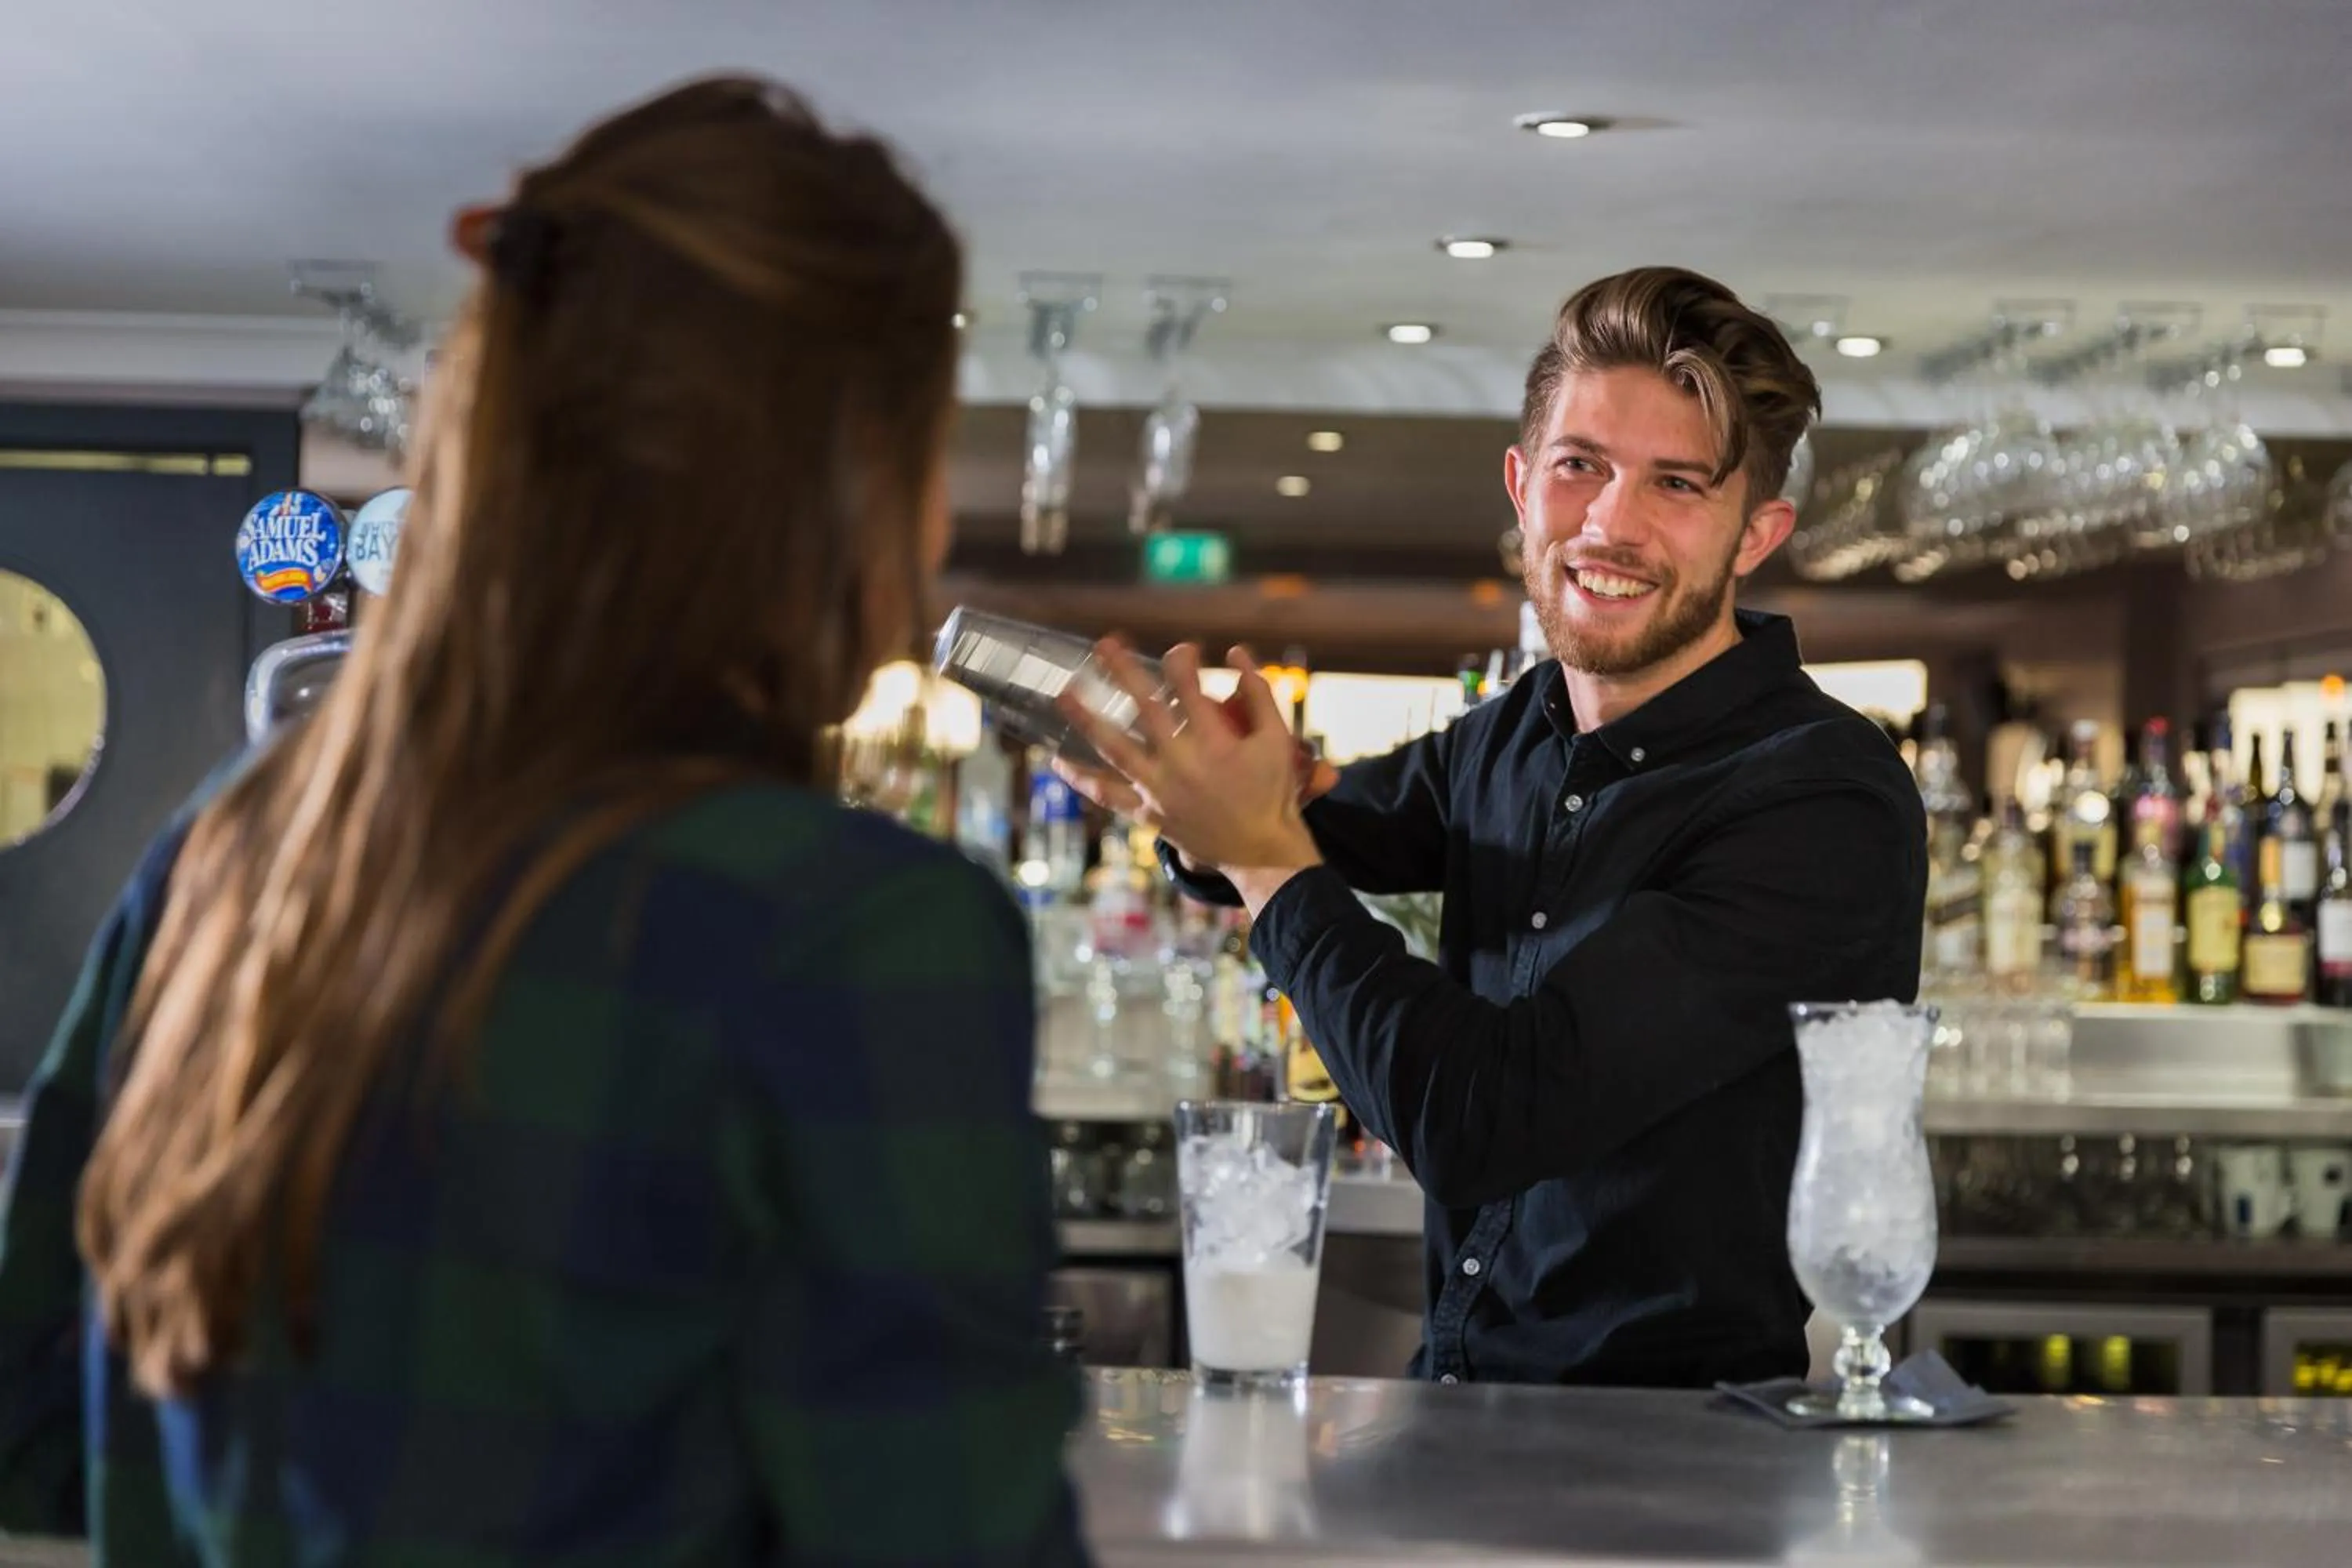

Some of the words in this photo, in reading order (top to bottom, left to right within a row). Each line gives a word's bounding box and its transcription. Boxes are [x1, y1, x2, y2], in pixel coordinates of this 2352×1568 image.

[245, 512, 326, 542] SAMUEL
[247, 537, 319, 571] ADAMS
[355, 534, 398, 561] BAY
